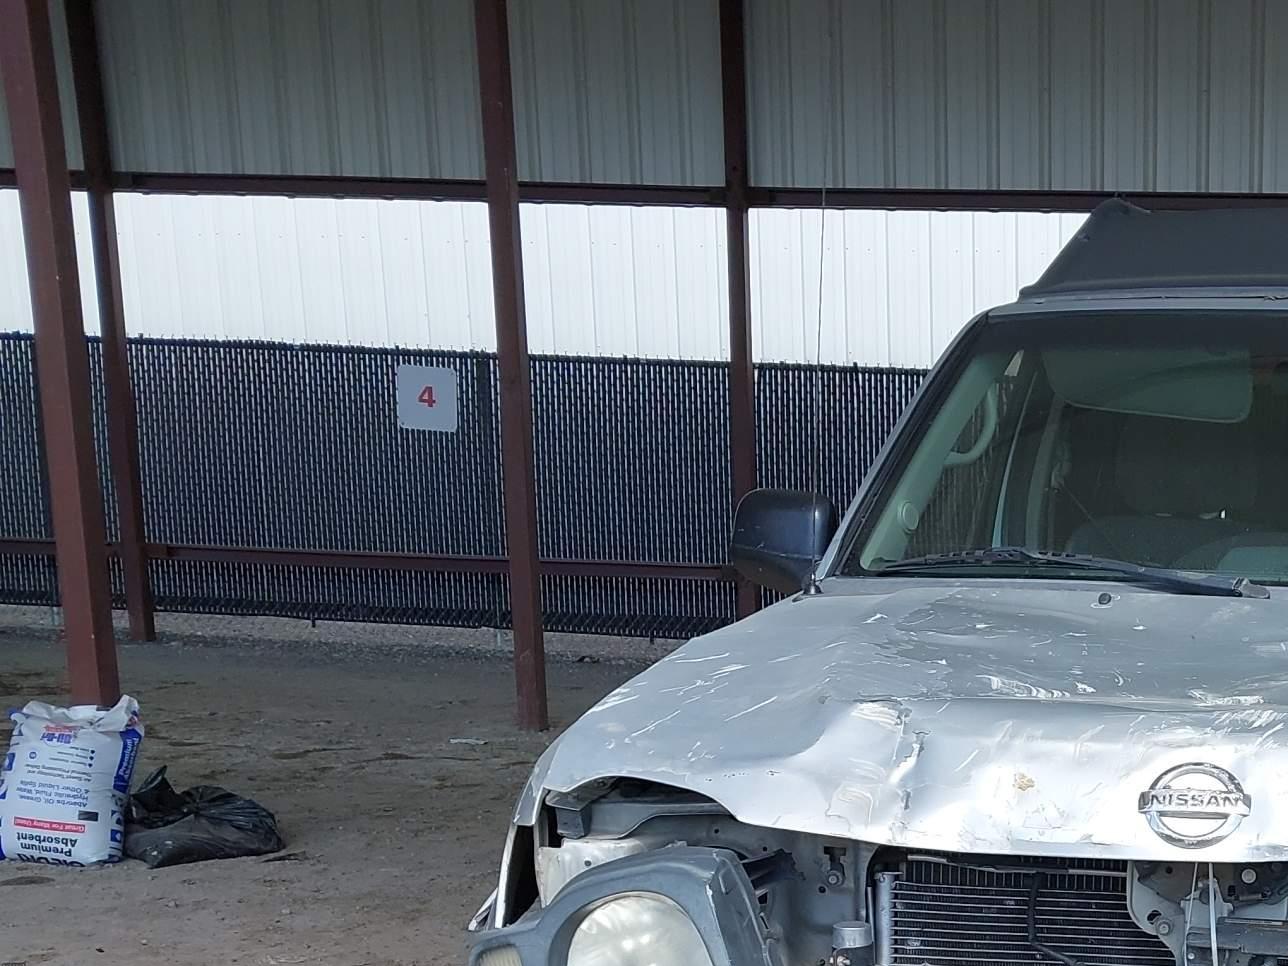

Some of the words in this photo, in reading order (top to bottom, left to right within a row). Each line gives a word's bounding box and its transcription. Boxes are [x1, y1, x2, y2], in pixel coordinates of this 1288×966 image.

[417, 386, 437, 408] 4
[38, 782, 60, 790] Liquid
[61, 785, 81, 794] Other
[56, 799, 87, 808] Absorbs
[1150, 794, 1240, 808] NISSAN
[16, 831, 78, 848] Absorbent
[20, 842, 72, 857] Premium
